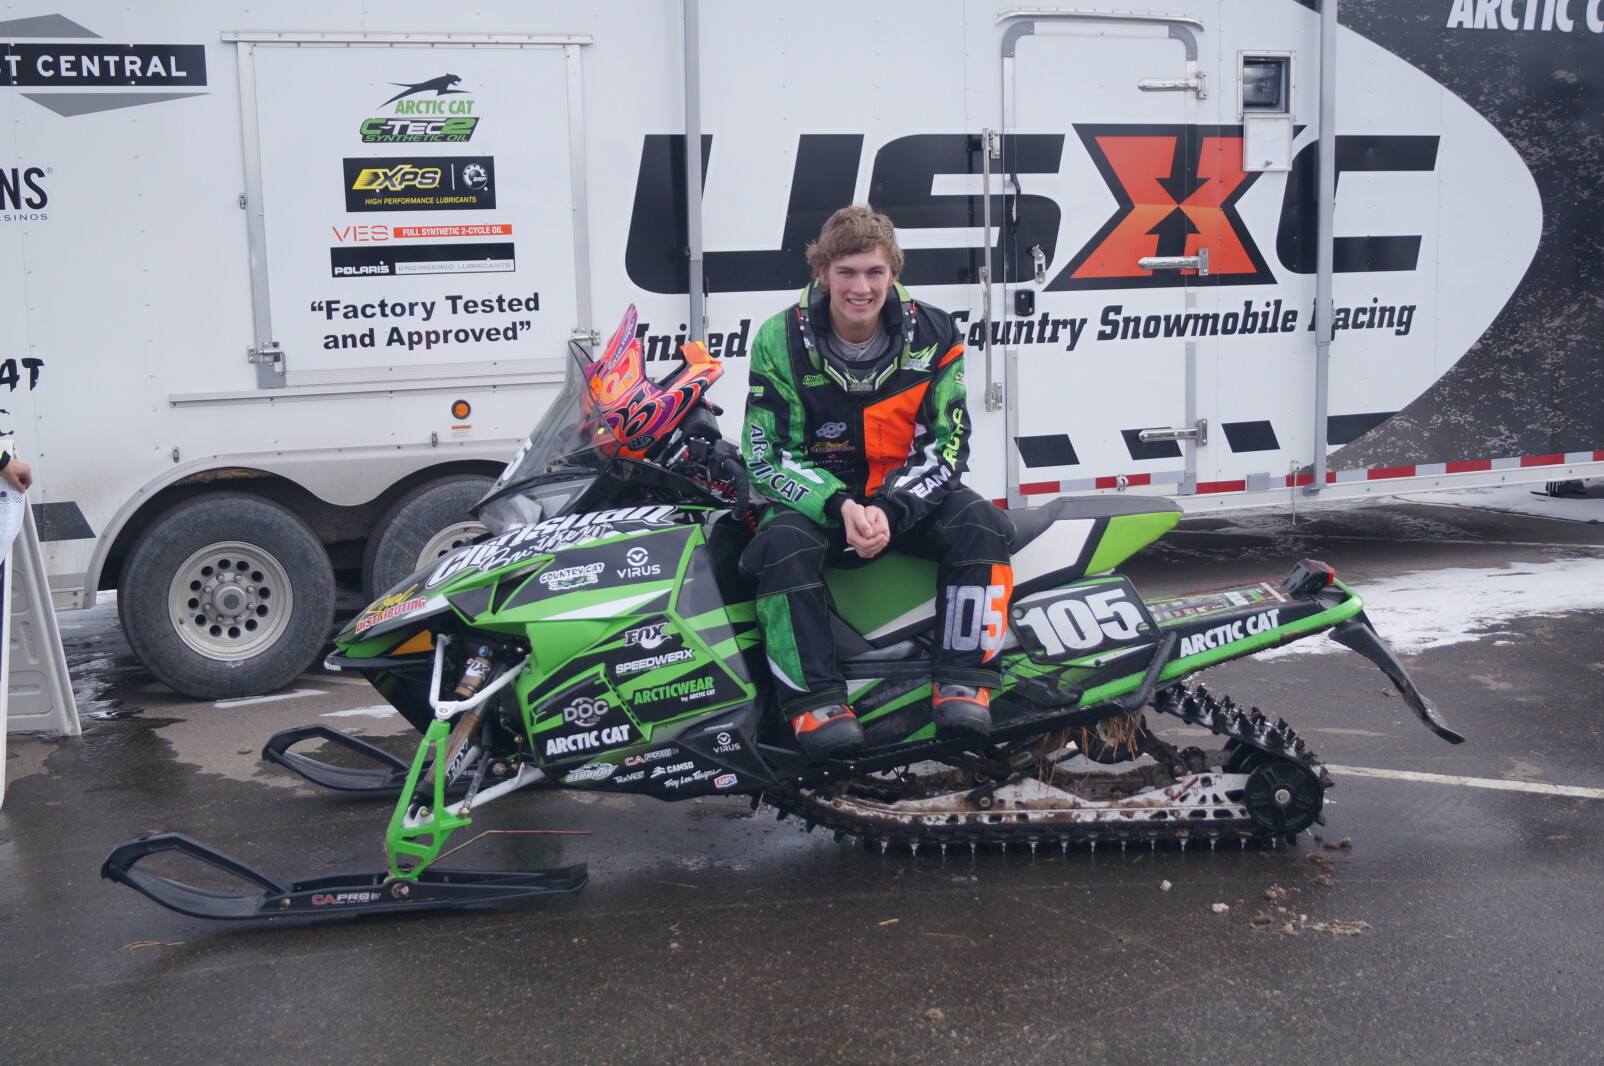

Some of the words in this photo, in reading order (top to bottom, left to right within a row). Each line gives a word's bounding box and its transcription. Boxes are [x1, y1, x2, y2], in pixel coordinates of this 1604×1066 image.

[36, 55, 188, 77] CENTRAL
[395, 100, 445, 115] ARCTIC
[448, 100, 475, 114] CAT
[364, 134, 442, 142] SYNTHETIC
[447, 134, 468, 142] OIL
[374, 165, 442, 190] XPS
[384, 197, 434, 205] PERFORMANCE
[436, 196, 477, 204] LUBRICANTS
[332, 226, 389, 242] VES
[403, 228, 419, 236] FULL
[422, 226, 459, 236] SYNTHETIC
[461, 225, 491, 235] 2-CYCLE
[492, 225, 503, 234] OIL
[334, 265, 389, 276] POLARIS
[398, 262, 455, 272] ENGINEERED
[457, 262, 511, 271] LUBRICANTS
[445, 292, 540, 315] Tested
[1097, 298, 1298, 342] Snowmobile
[323, 327, 375, 350] and
[769, 472, 811, 503] CAT
[907, 464, 952, 498] EAM
[540, 566, 586, 583] COUNTRY
[584, 562, 605, 575] CAT
[617, 565, 661, 578] VIRUS
[356, 596, 427, 634] DISTRIBUTING
[943, 585, 1004, 651] 105
[1016, 588, 1144, 656] 105
[625, 622, 671, 648] FOX
[1180, 620, 1244, 658] ARCTIC
[1246, 609, 1280, 635] CAT
[616, 648, 694, 674] SPEEDWERX
[634, 676, 715, 705] ARCTICWEAR
[689, 691, 706, 700] ARCTIC
[706, 688, 716, 696] CAT
[563, 700, 609, 722] DOC
[546, 730, 600, 756] ARCTIC
[601, 724, 630, 744] CAT
[713, 743, 741, 754] VIRUS
[667, 761, 694, 774] CAMSO
[664, 779, 680, 788] Troy
[680, 775, 693, 784] Lee
